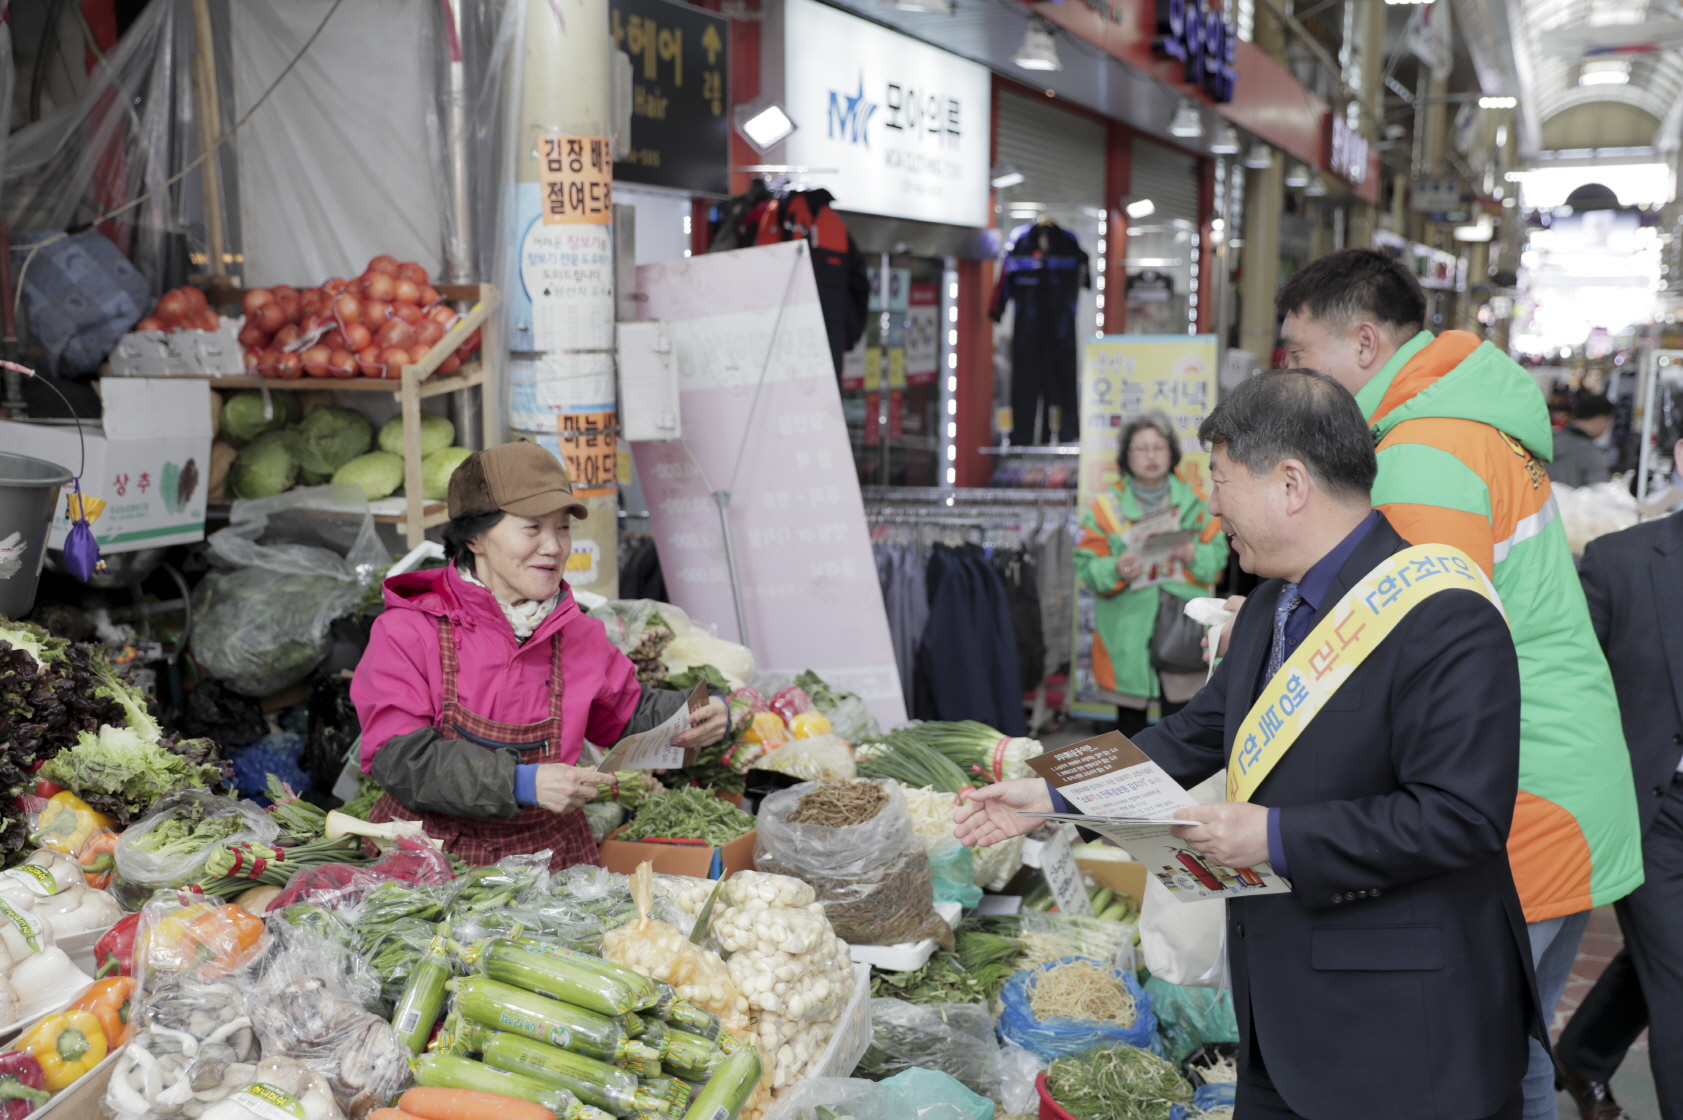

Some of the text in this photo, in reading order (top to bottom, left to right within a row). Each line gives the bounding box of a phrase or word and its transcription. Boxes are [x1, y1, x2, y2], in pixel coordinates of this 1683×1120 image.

[885, 82, 961, 148] 모아의류
[1237, 555, 1476, 775] 안전한 나라 행복한
